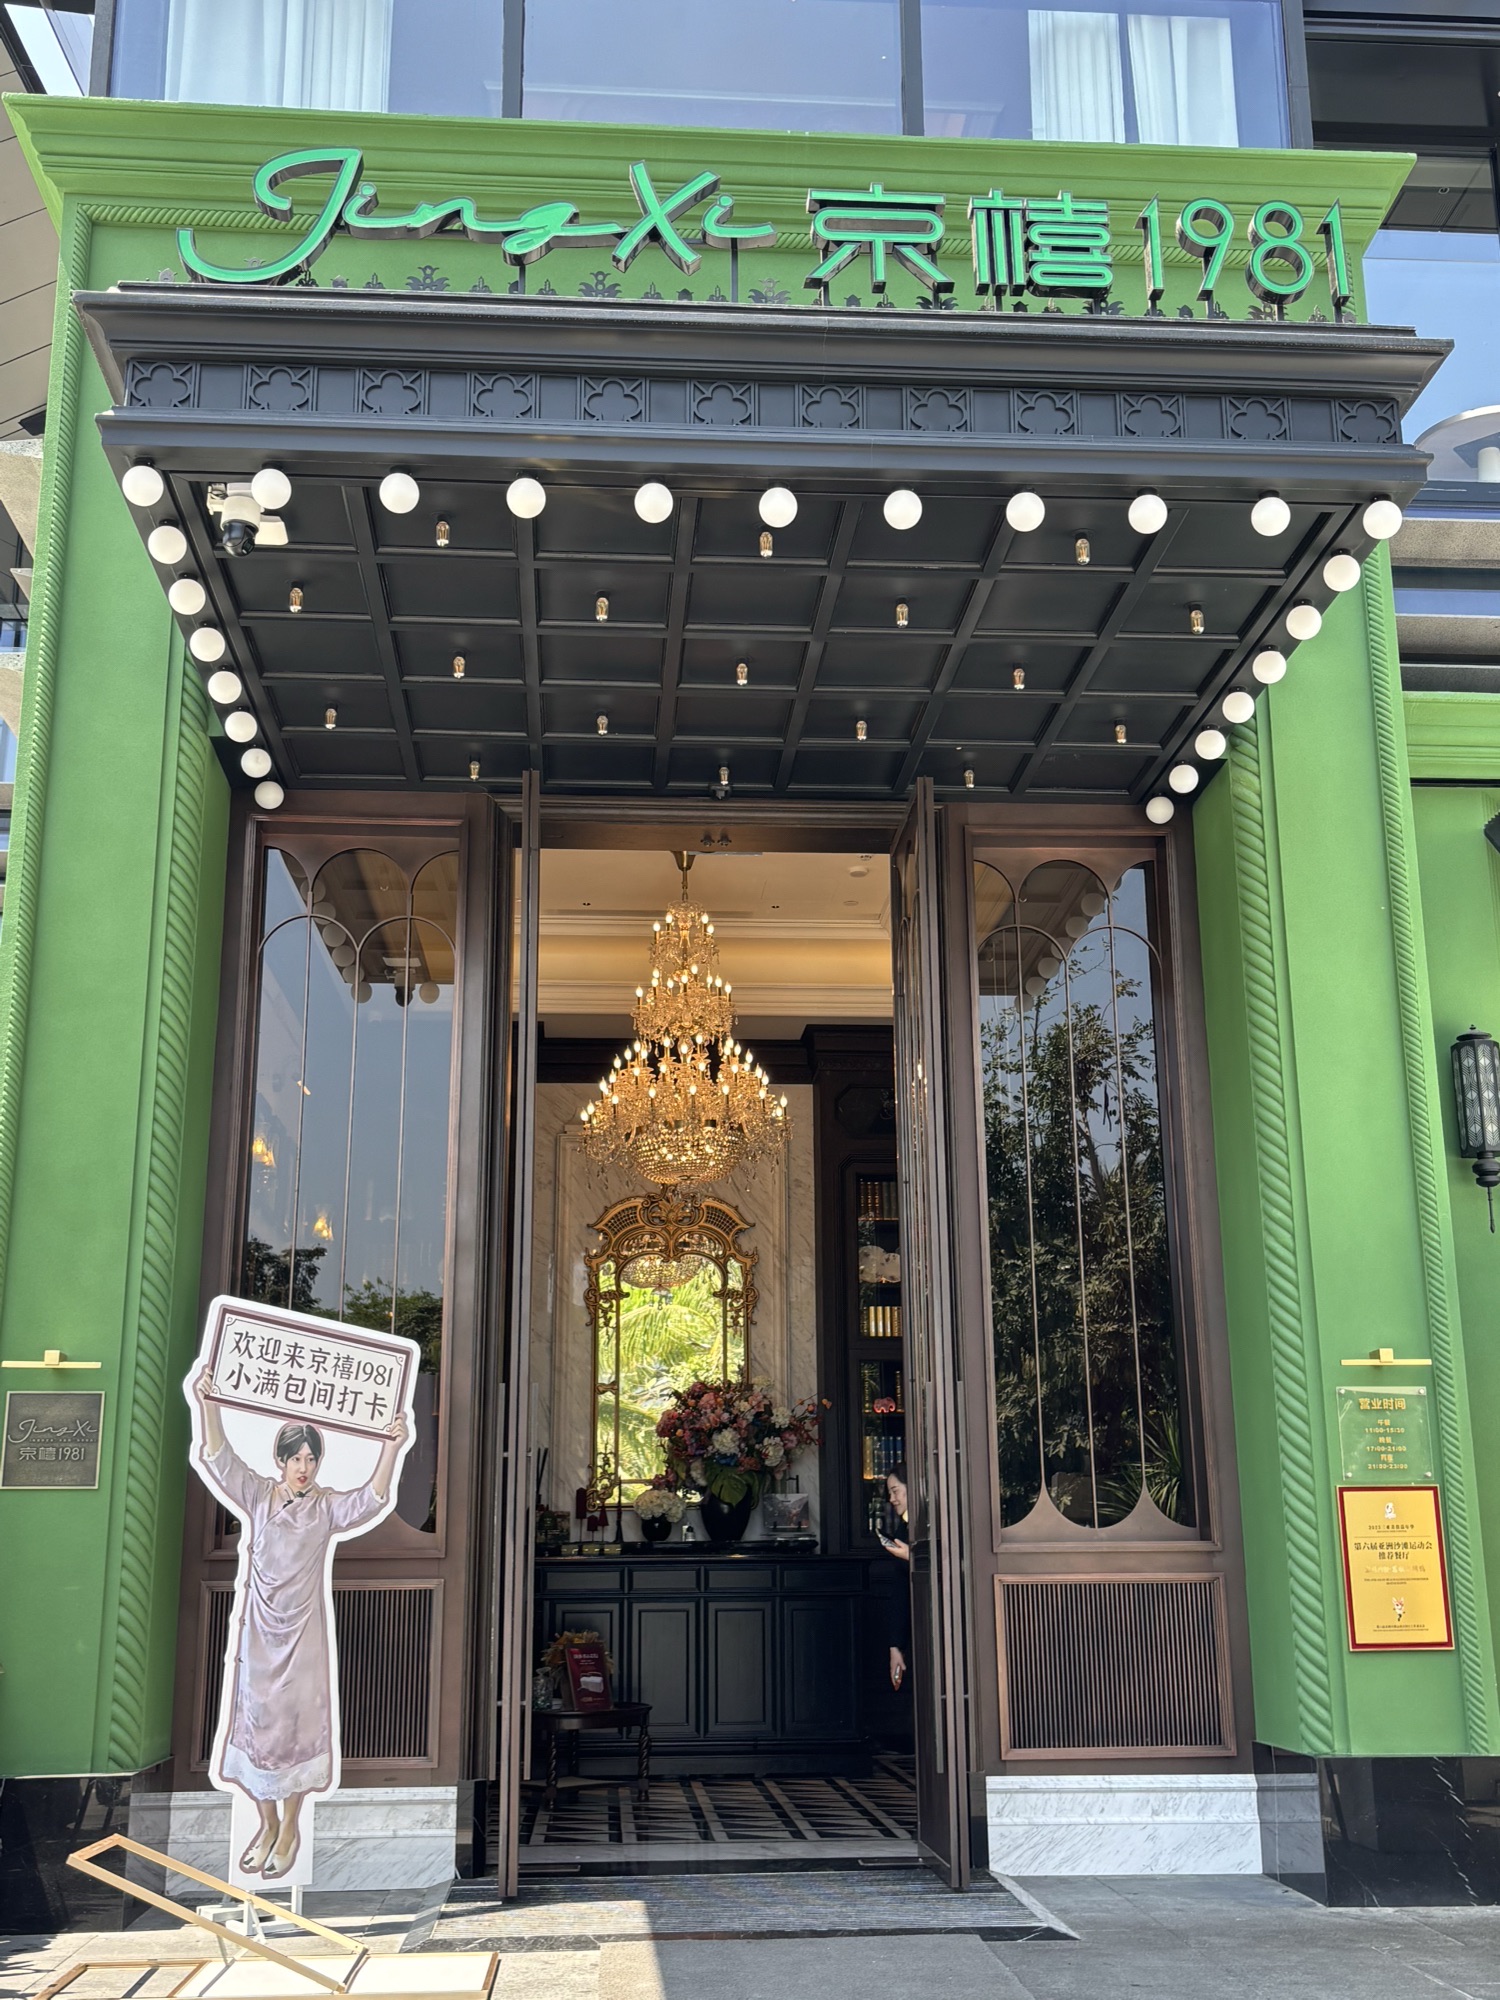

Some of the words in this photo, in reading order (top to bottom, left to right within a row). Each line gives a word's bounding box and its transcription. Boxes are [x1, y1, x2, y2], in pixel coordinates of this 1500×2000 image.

[176, 147, 778, 283] JingXi
[229, 1331, 394, 1388] 欢迎来京禧1981
[225, 1362, 388, 1421] 小满包间打卡
[1358, 1398, 1406, 1410] 营业时间
